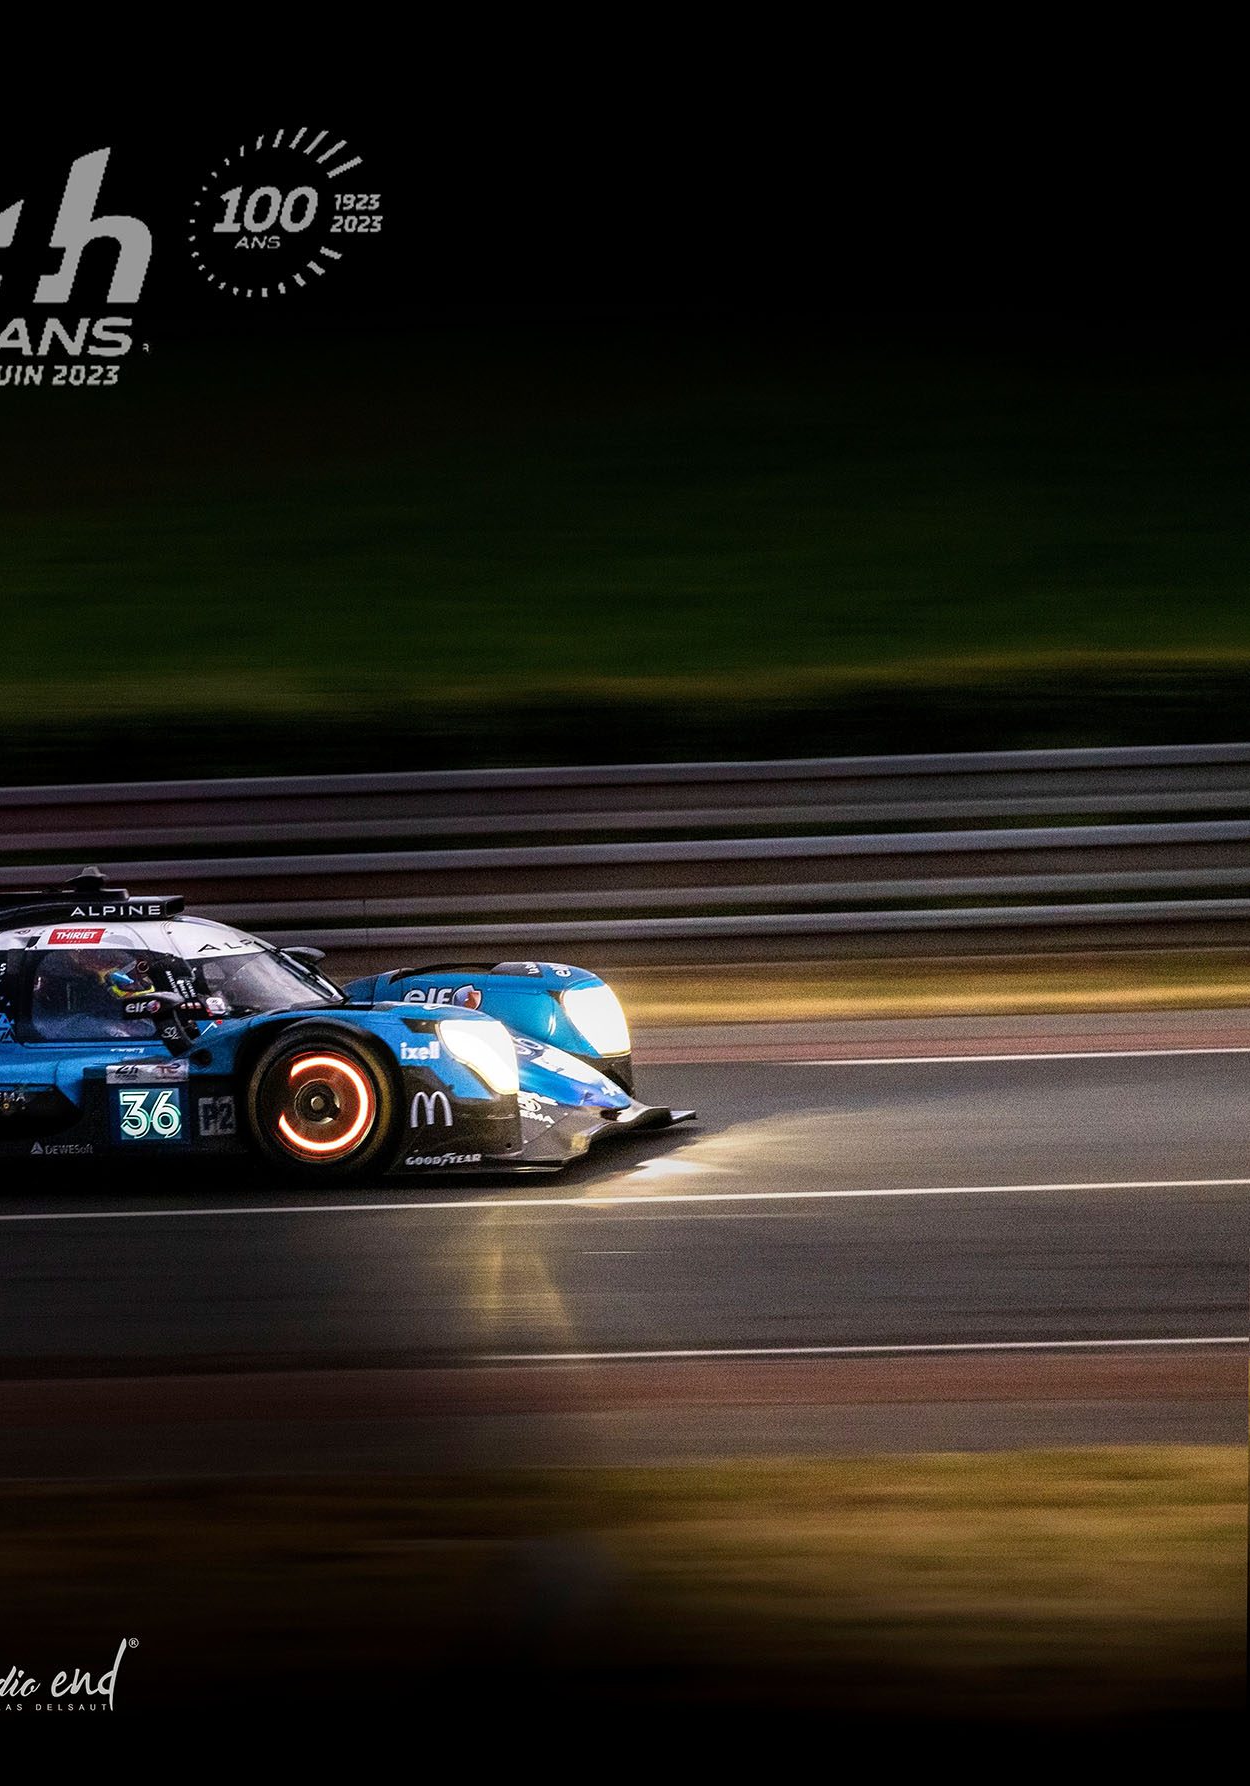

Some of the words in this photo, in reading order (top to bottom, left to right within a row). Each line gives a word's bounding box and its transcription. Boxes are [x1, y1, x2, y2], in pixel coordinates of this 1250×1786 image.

[70, 905, 162, 917] ALPINE
[56, 931, 99, 940] THIRIET
[402, 988, 452, 1004] elf
[125, 1001, 147, 1013] elf
[400, 1041, 442, 1060] ixell
[120, 1090, 182, 1139] 36
[404, 1152, 482, 1167] GOODYEAR
